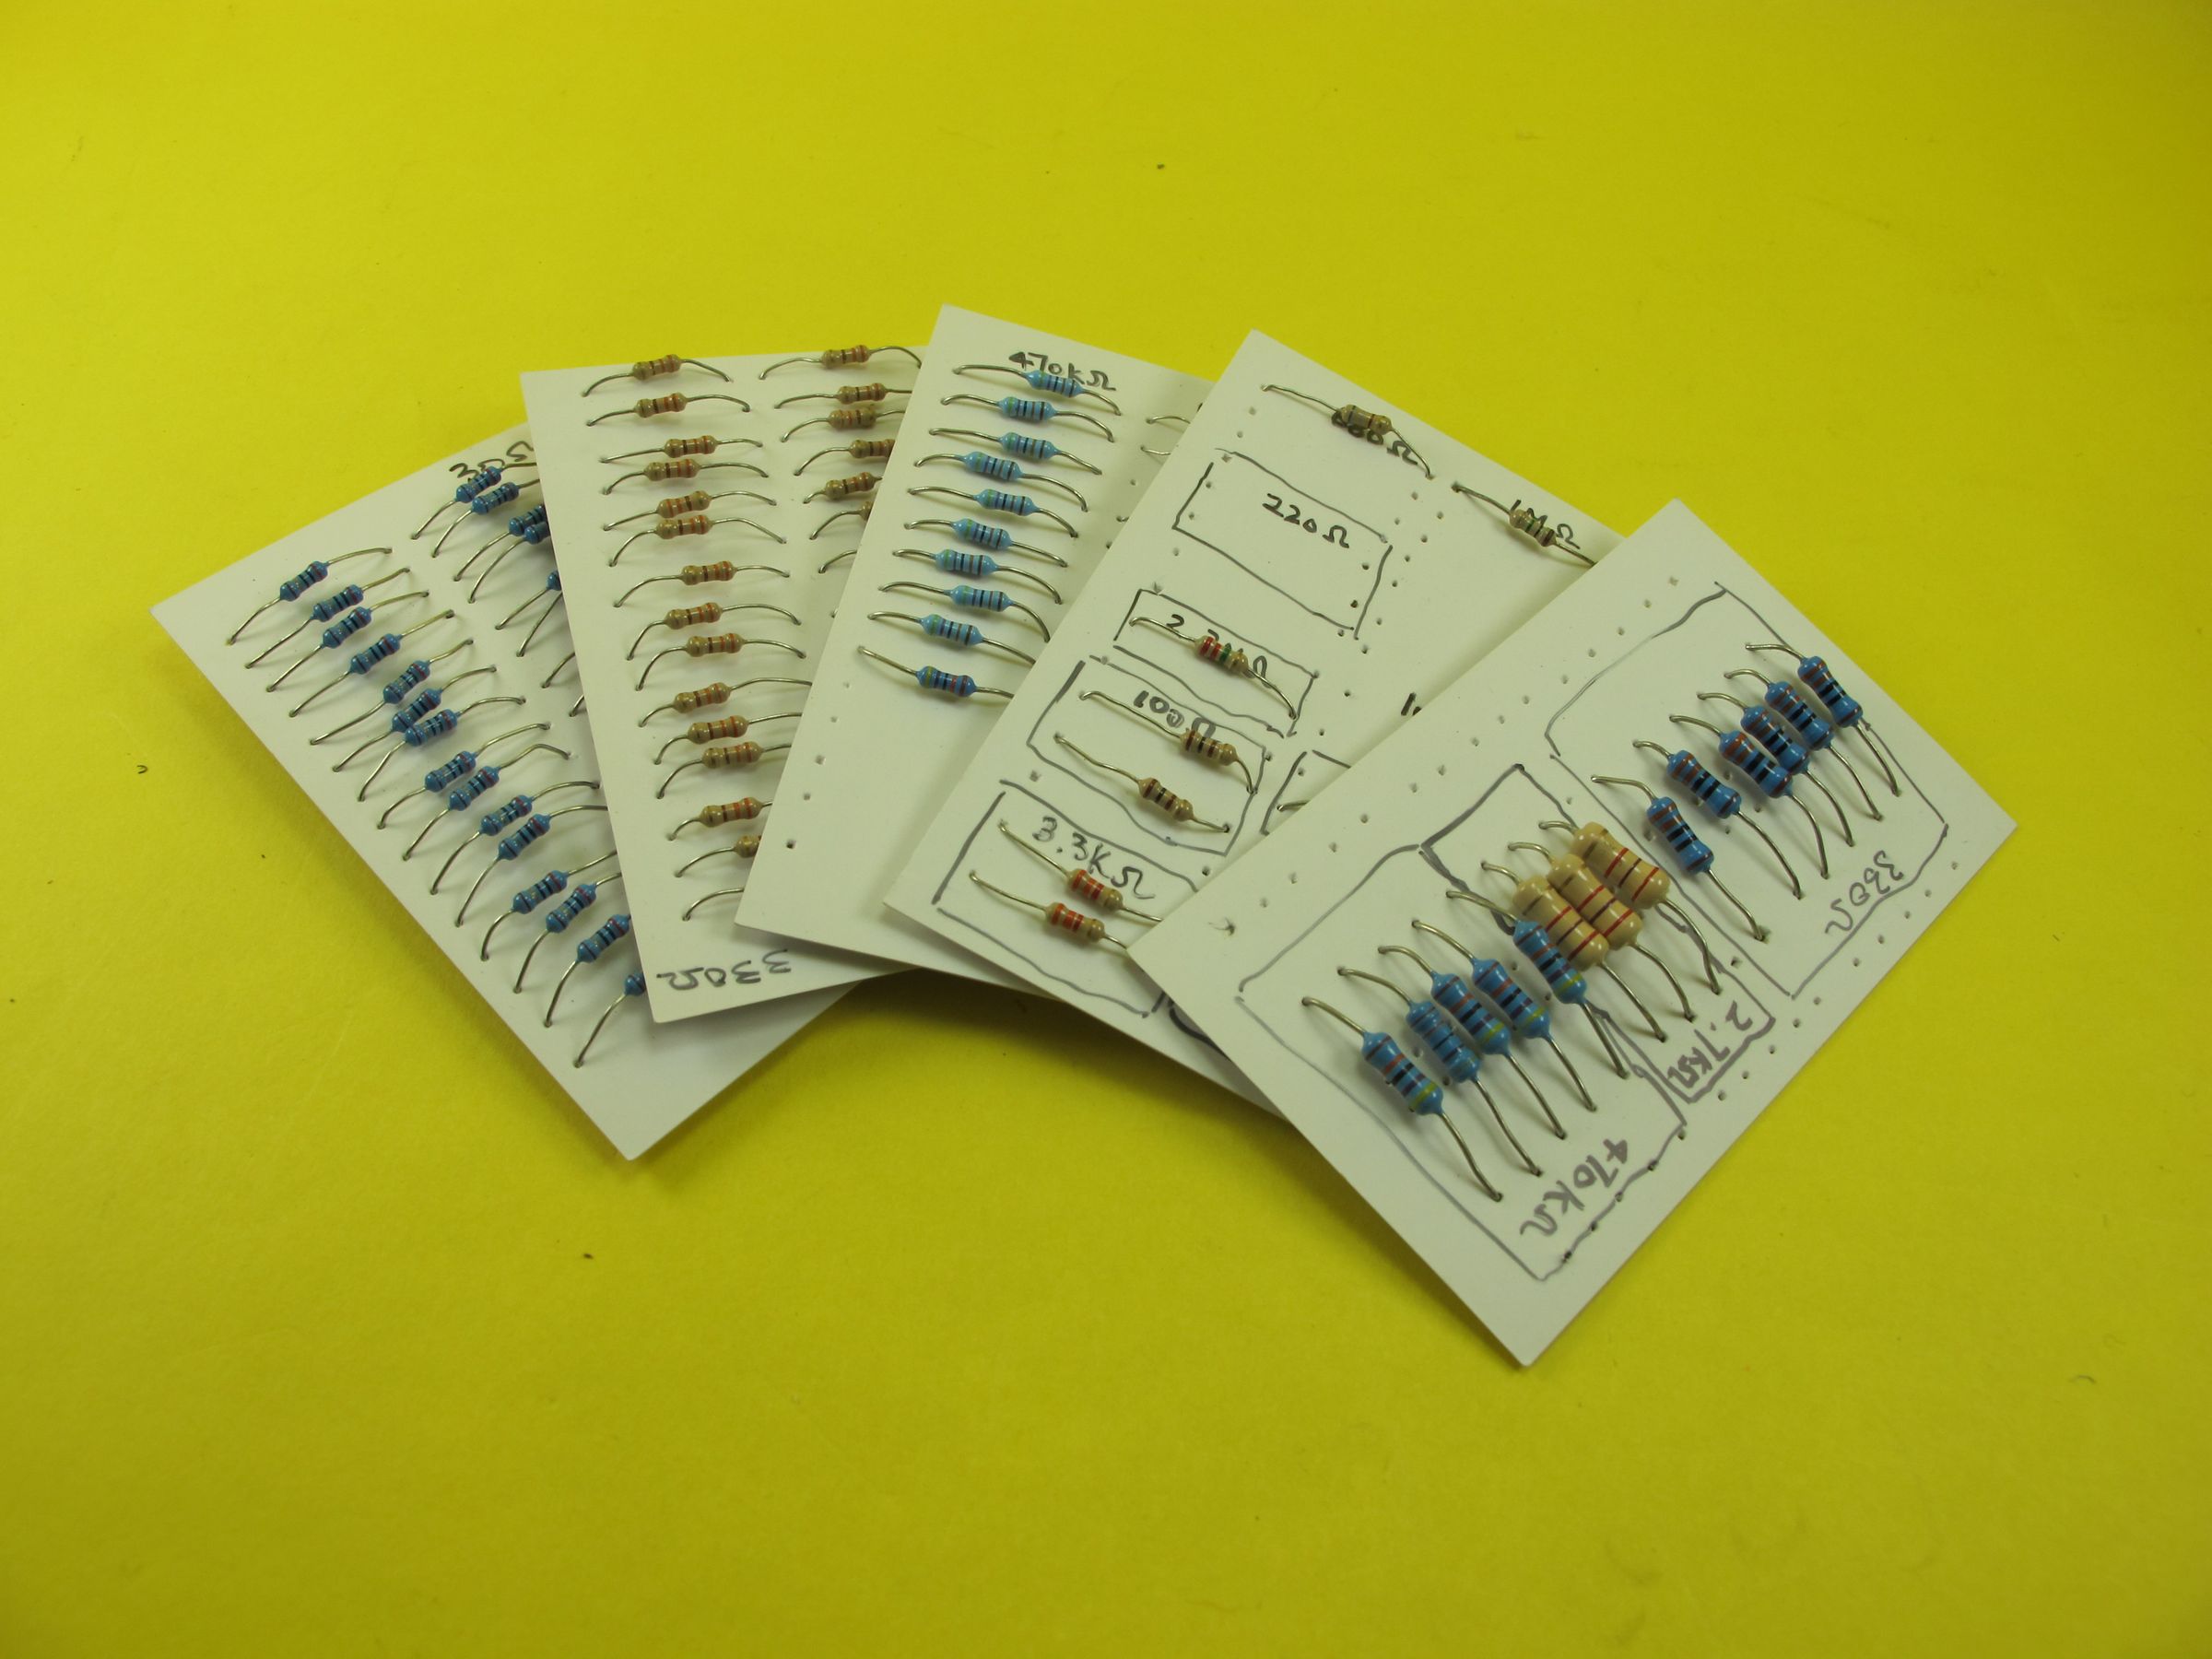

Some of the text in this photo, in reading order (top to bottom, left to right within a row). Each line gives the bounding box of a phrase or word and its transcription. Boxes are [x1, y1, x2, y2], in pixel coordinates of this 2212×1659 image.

[1008, 351, 1116, 391] 470kΩ
[1261, 492, 1350, 549] 220Ω
[655, 947, 792, 991] 330Ω
